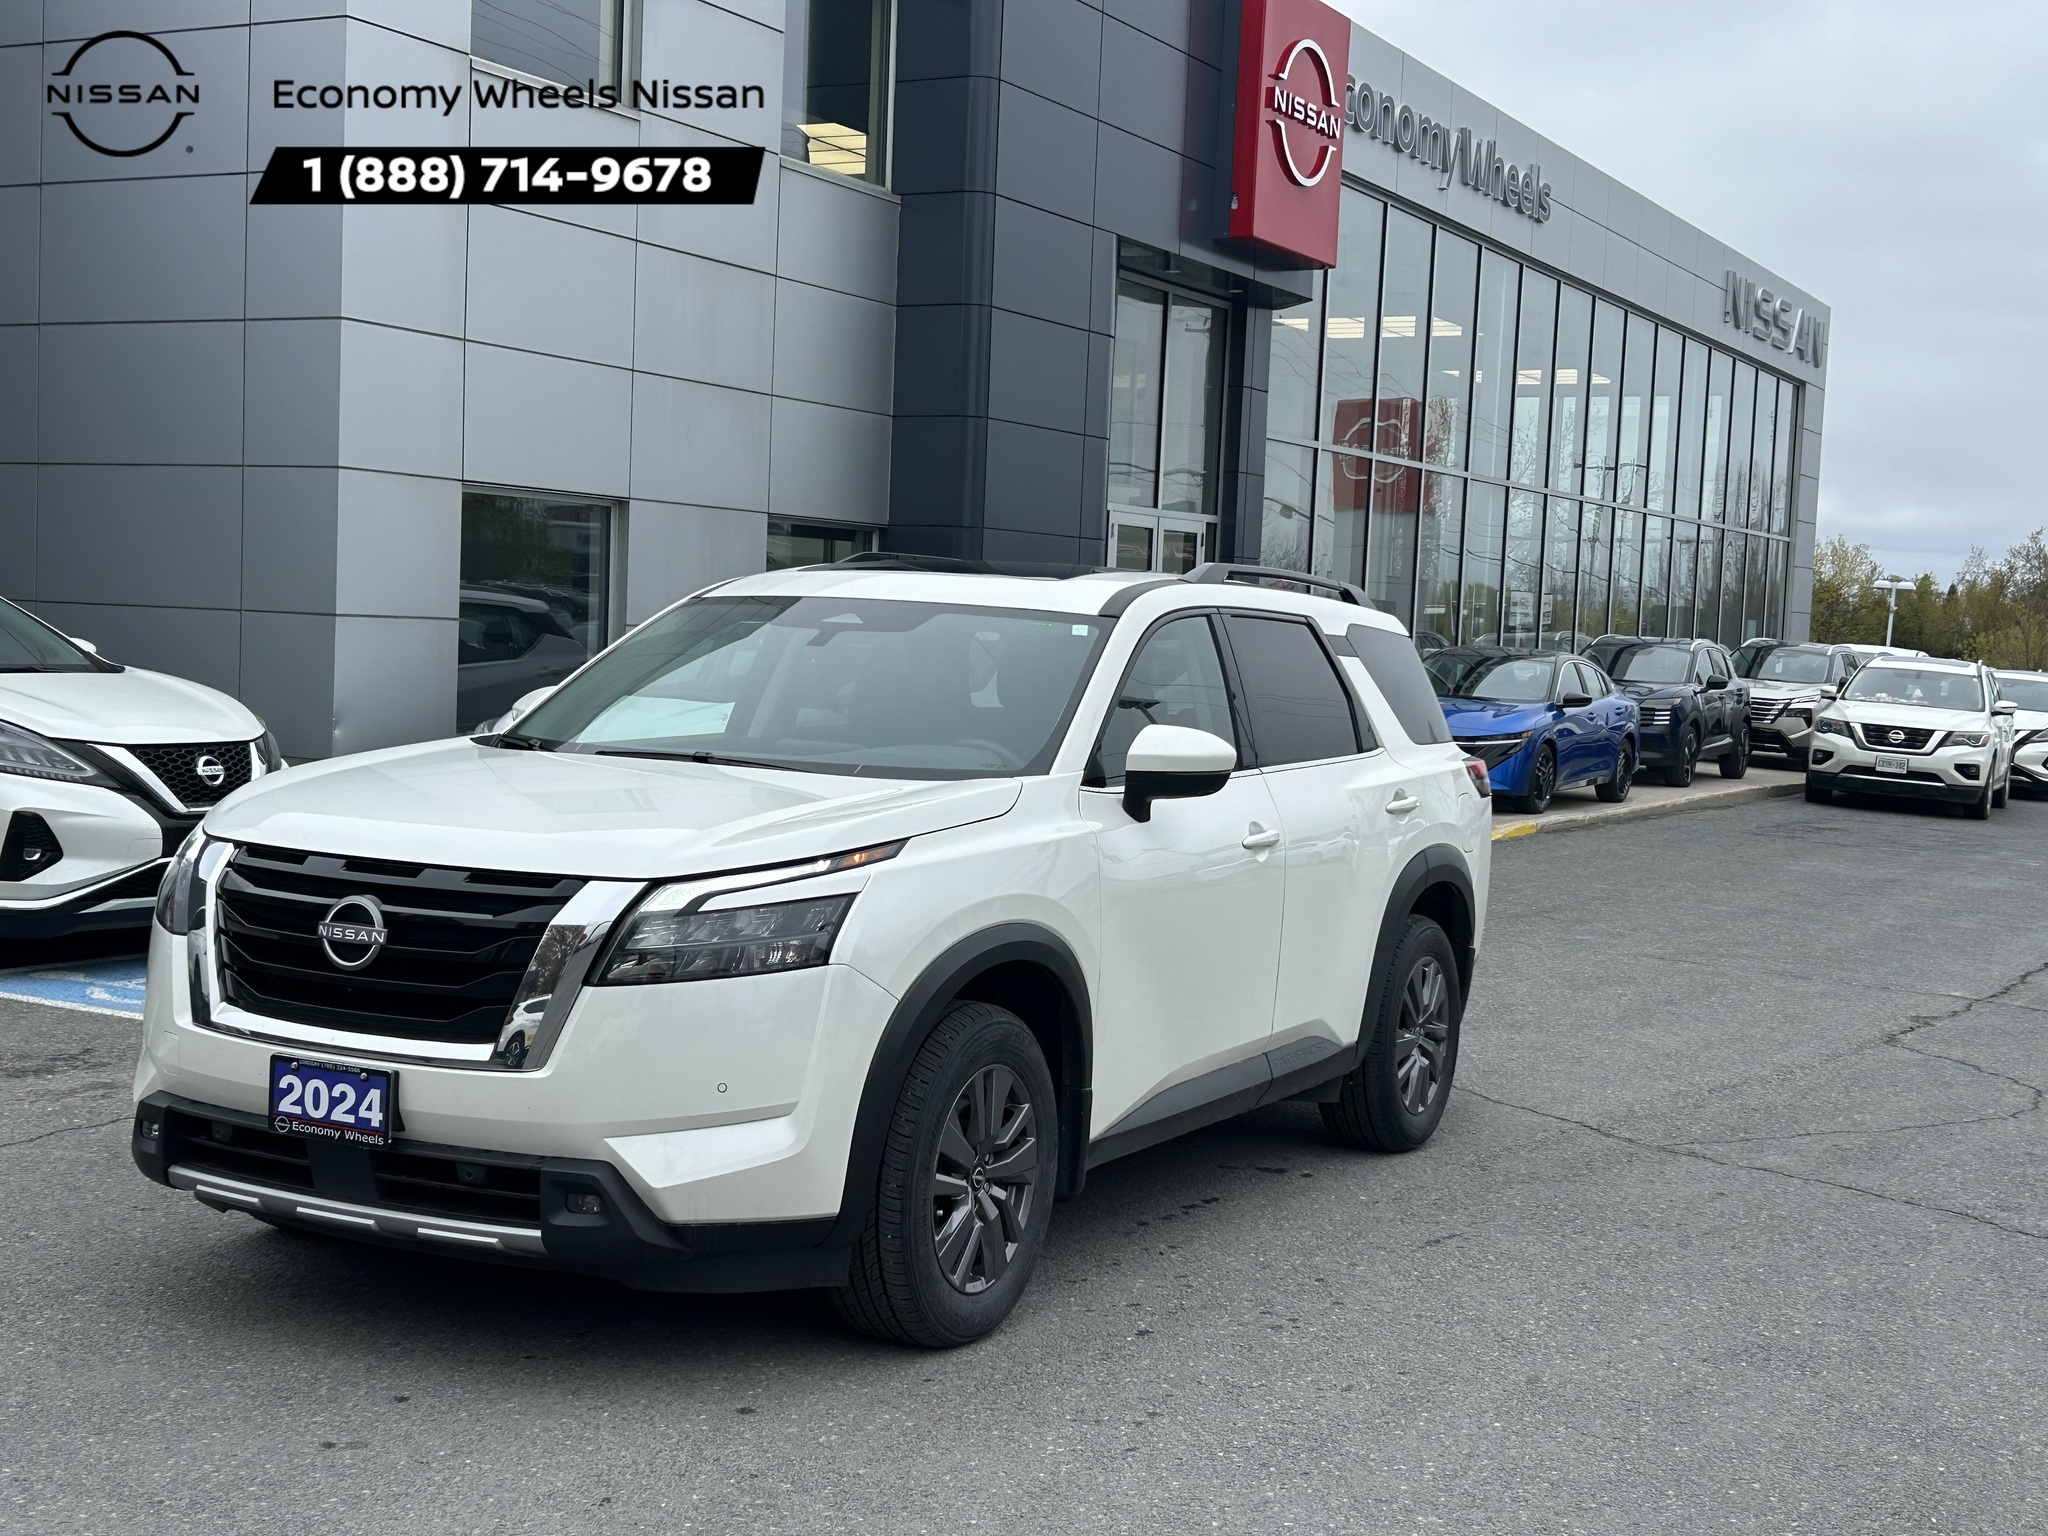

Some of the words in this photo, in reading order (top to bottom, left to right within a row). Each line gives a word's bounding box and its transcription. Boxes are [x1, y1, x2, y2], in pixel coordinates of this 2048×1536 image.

[1273, 85, 1341, 140] NISSAN
[1344, 74, 1461, 190] conomy
[1460, 127, 1552, 224] Wheels
[1723, 269, 1825, 368] NISSAN
[319, 924, 385, 943] NISSAN
[278, 1074, 383, 1128] 2024
[292, 1121, 341, 1140] Economy
[344, 1129, 384, 1146] Wheels
